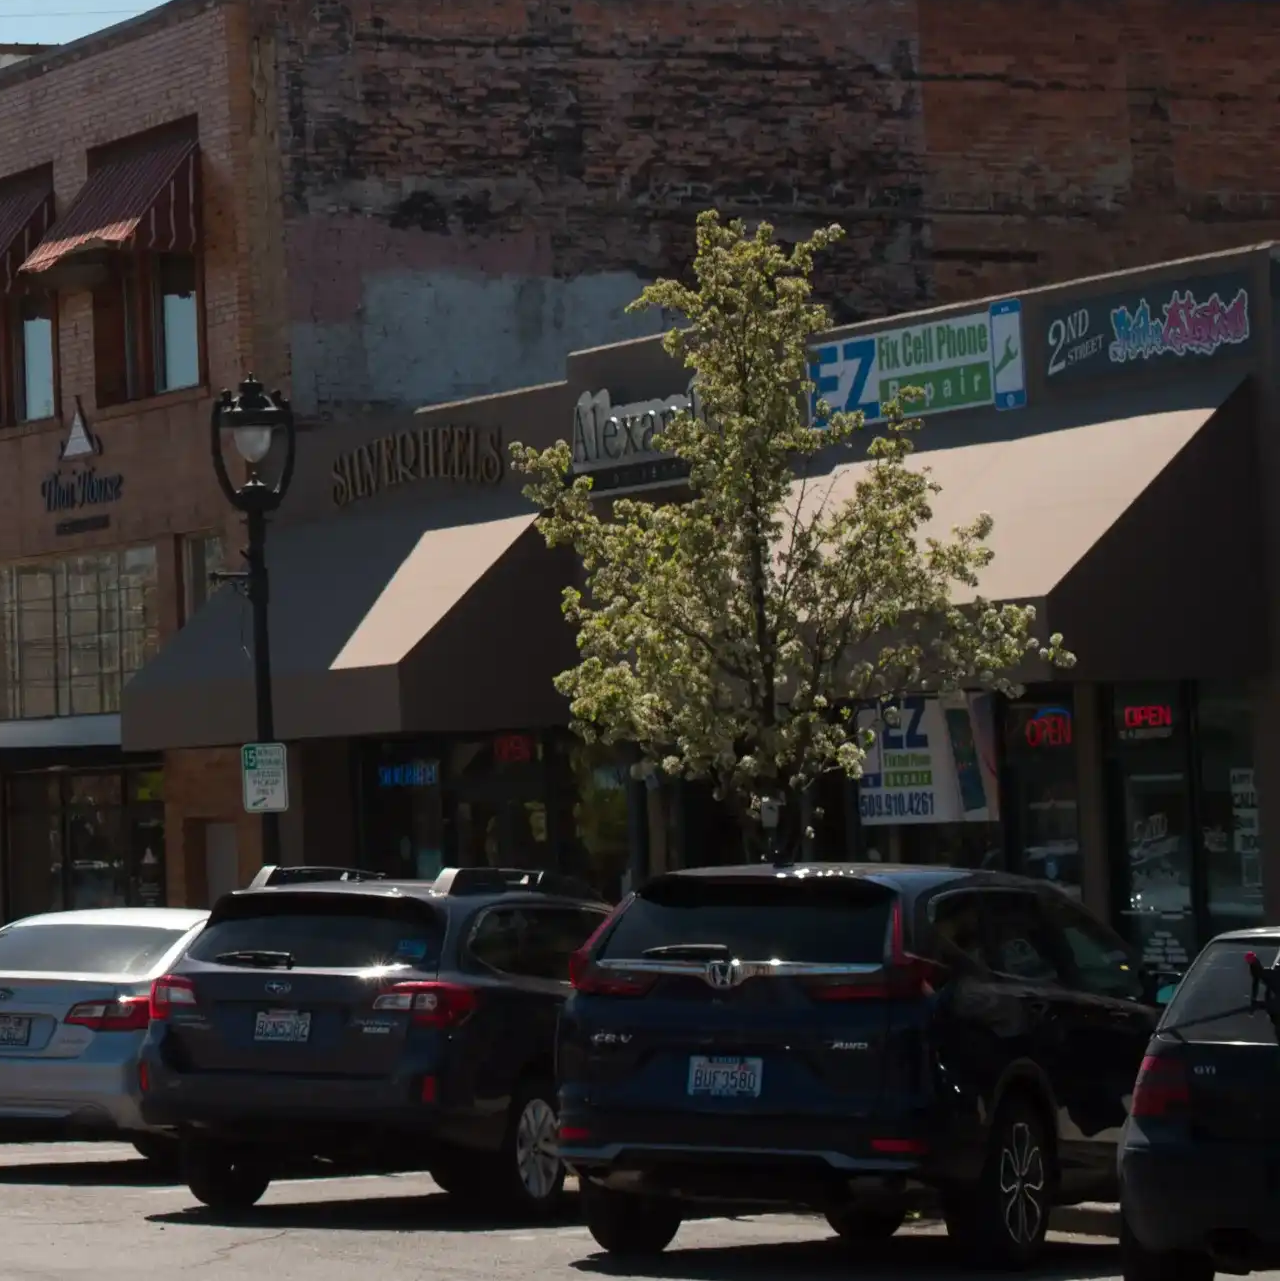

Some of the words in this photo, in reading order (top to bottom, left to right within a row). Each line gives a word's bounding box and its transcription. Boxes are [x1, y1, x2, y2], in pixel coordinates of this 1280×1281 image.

[878, 336, 900, 372] Fix
[901, 327, 934, 367] Cell
[936, 322, 988, 361] Phone
[1067, 334, 1105, 366] STREET
[809, 338, 880, 428] EZ
[889, 367, 982, 407] Rpair
[331, 423, 505, 507] SILVERHEELS
[1025, 715, 1073, 748] OPEN
[1125, 704, 1172, 728] OPEN
[244, 749, 257, 767] 15
